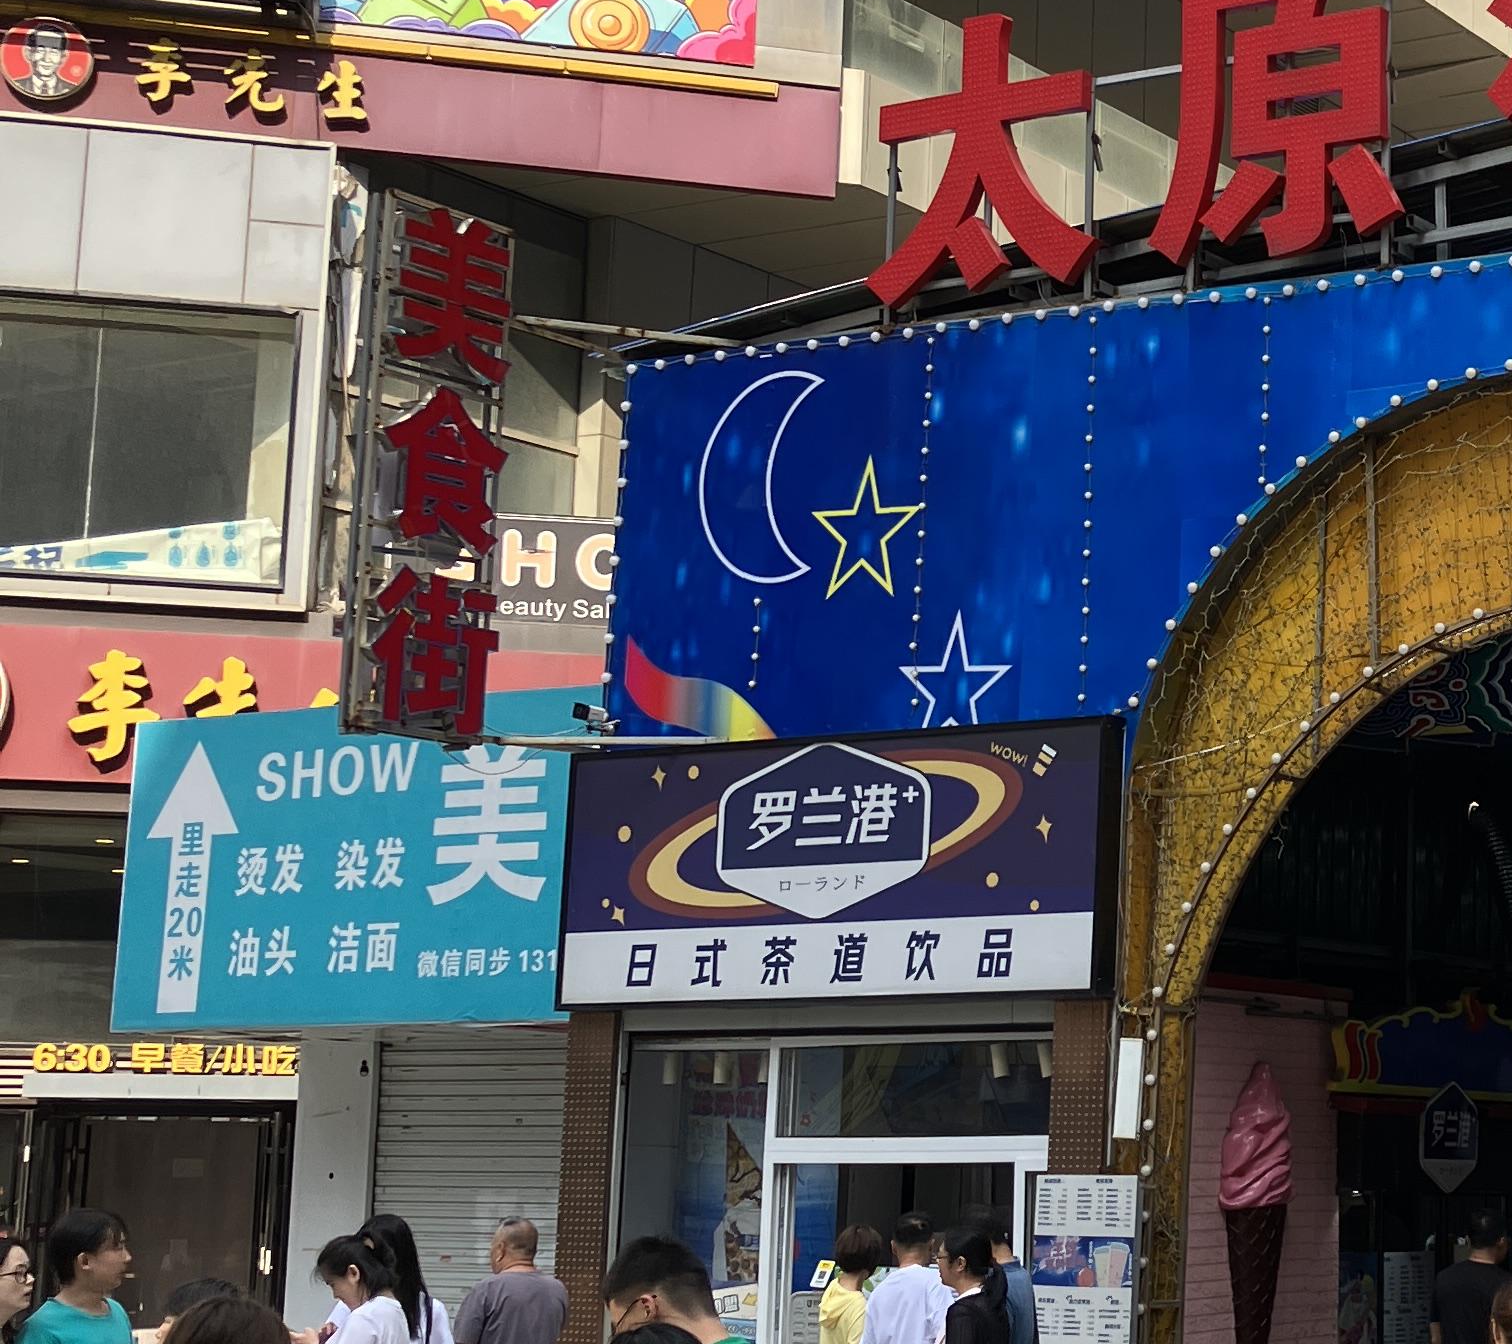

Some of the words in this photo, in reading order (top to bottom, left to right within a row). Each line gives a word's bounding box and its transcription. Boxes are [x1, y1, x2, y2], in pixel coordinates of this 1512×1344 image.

[371, 207, 511, 735] 美食街
[256, 741, 420, 803] SHOW
[425, 744, 548, 906] 美
[234, 843, 305, 897] 烫发
[334, 837, 406, 891] 染发
[779, 873, 867, 894] ローランド
[227, 925, 298, 977] 油头
[326, 921, 401, 973] 洁面
[416, 946, 512, 978] 微信同步
[625, 926, 1014, 989] 日式茶道饮品
[32, 1042, 111, 1074] 6:30
[130, 1042, 298, 1076] 早餐/小吃
